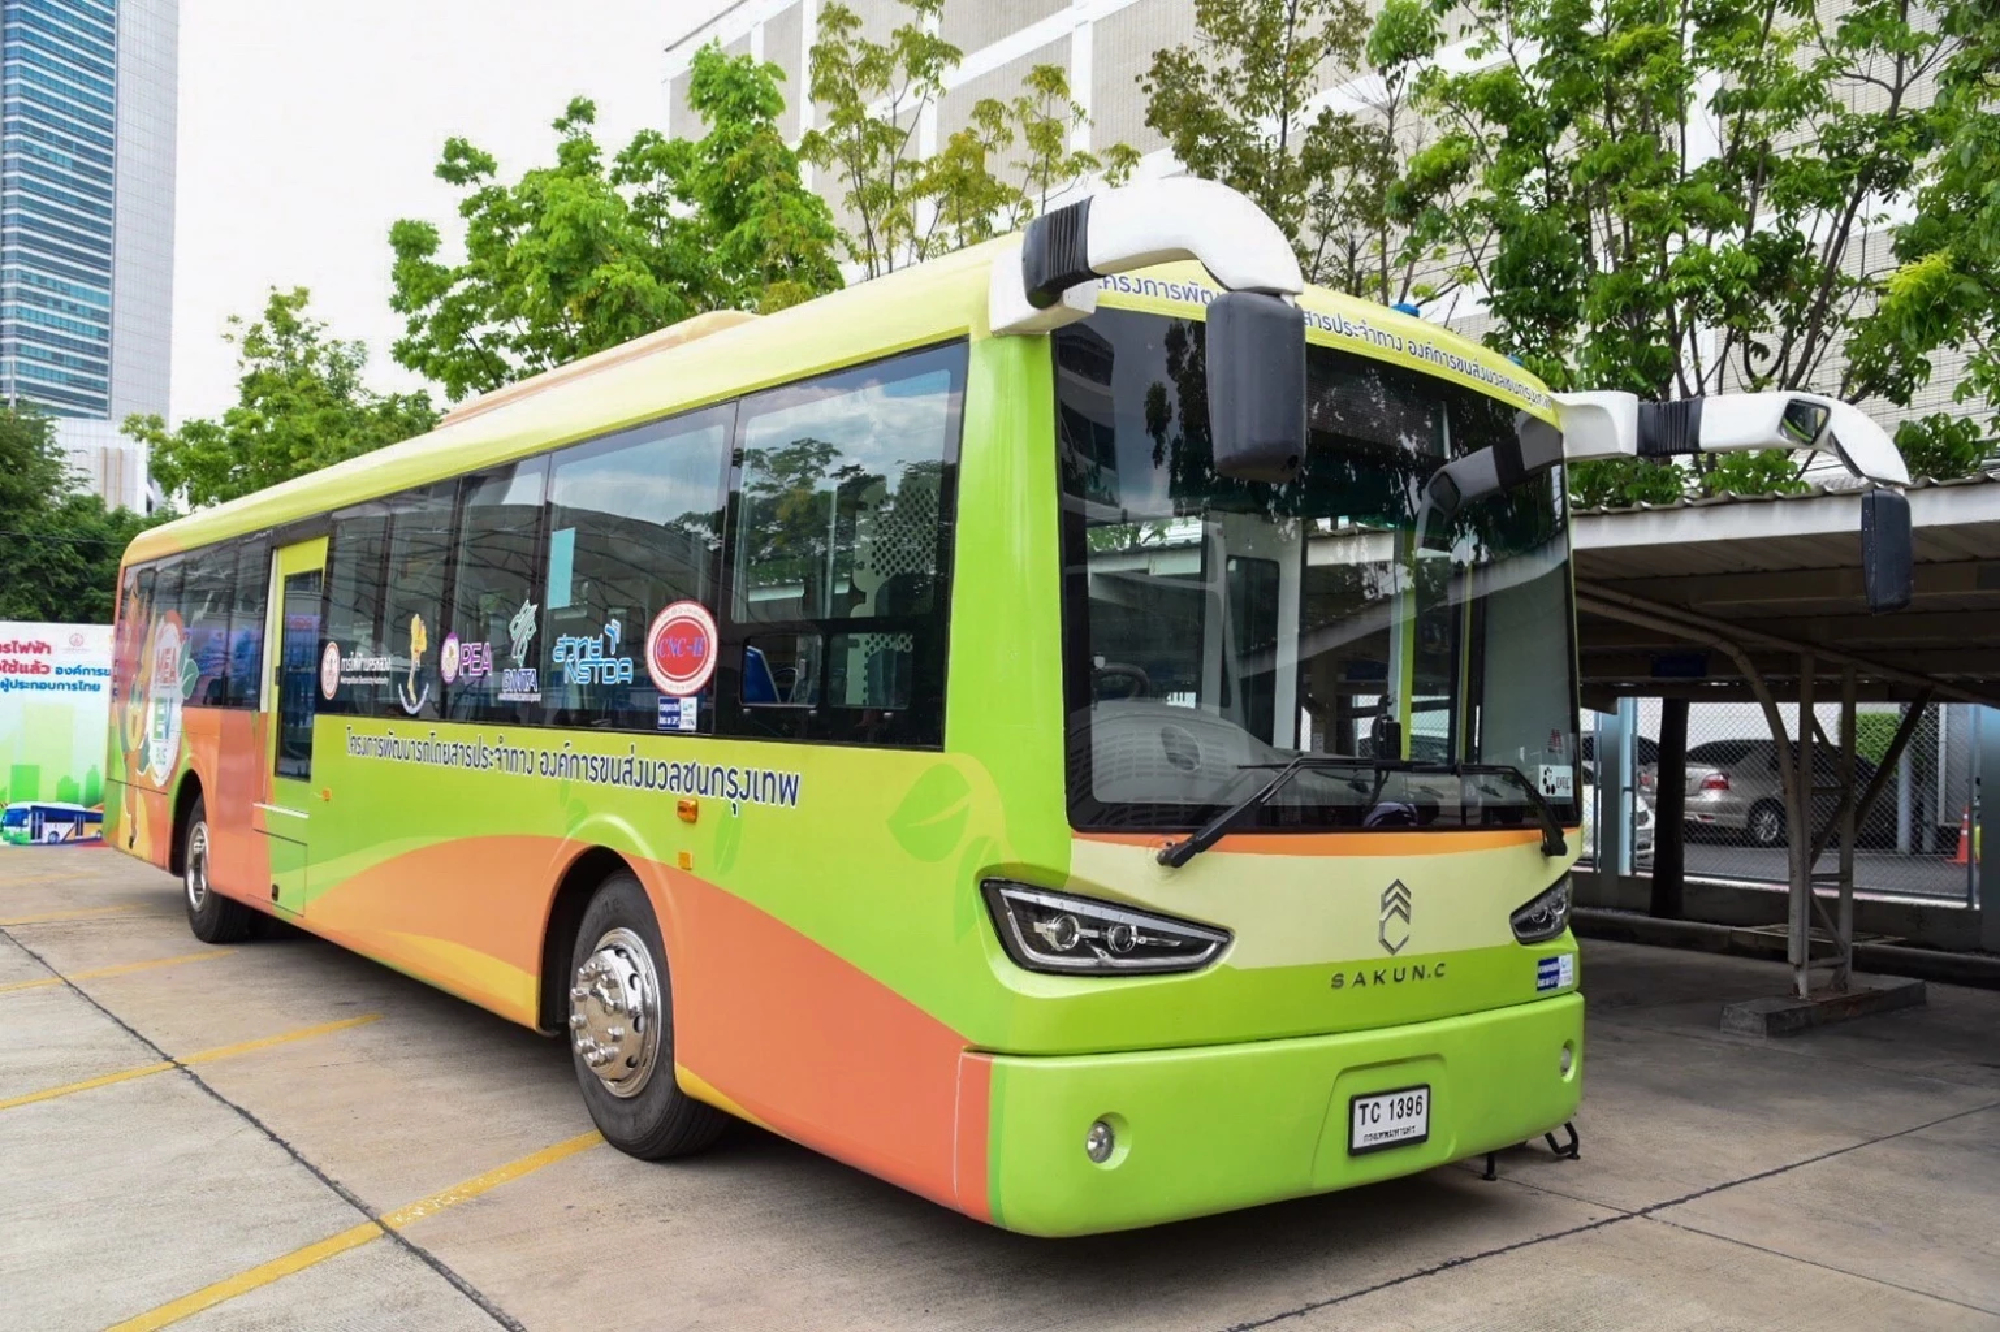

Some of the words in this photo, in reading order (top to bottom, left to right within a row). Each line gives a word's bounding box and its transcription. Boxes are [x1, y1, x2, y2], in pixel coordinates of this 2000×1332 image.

[459, 643, 493, 676] PEA
[539, 740, 801, 818] องค์การขนส่งมวลชนกรุงเทพ
[1330, 962, 1447, 990] SAKUN.C
[1358, 1102, 1381, 1125] TC
[1389, 1094, 1423, 1120] 1396
